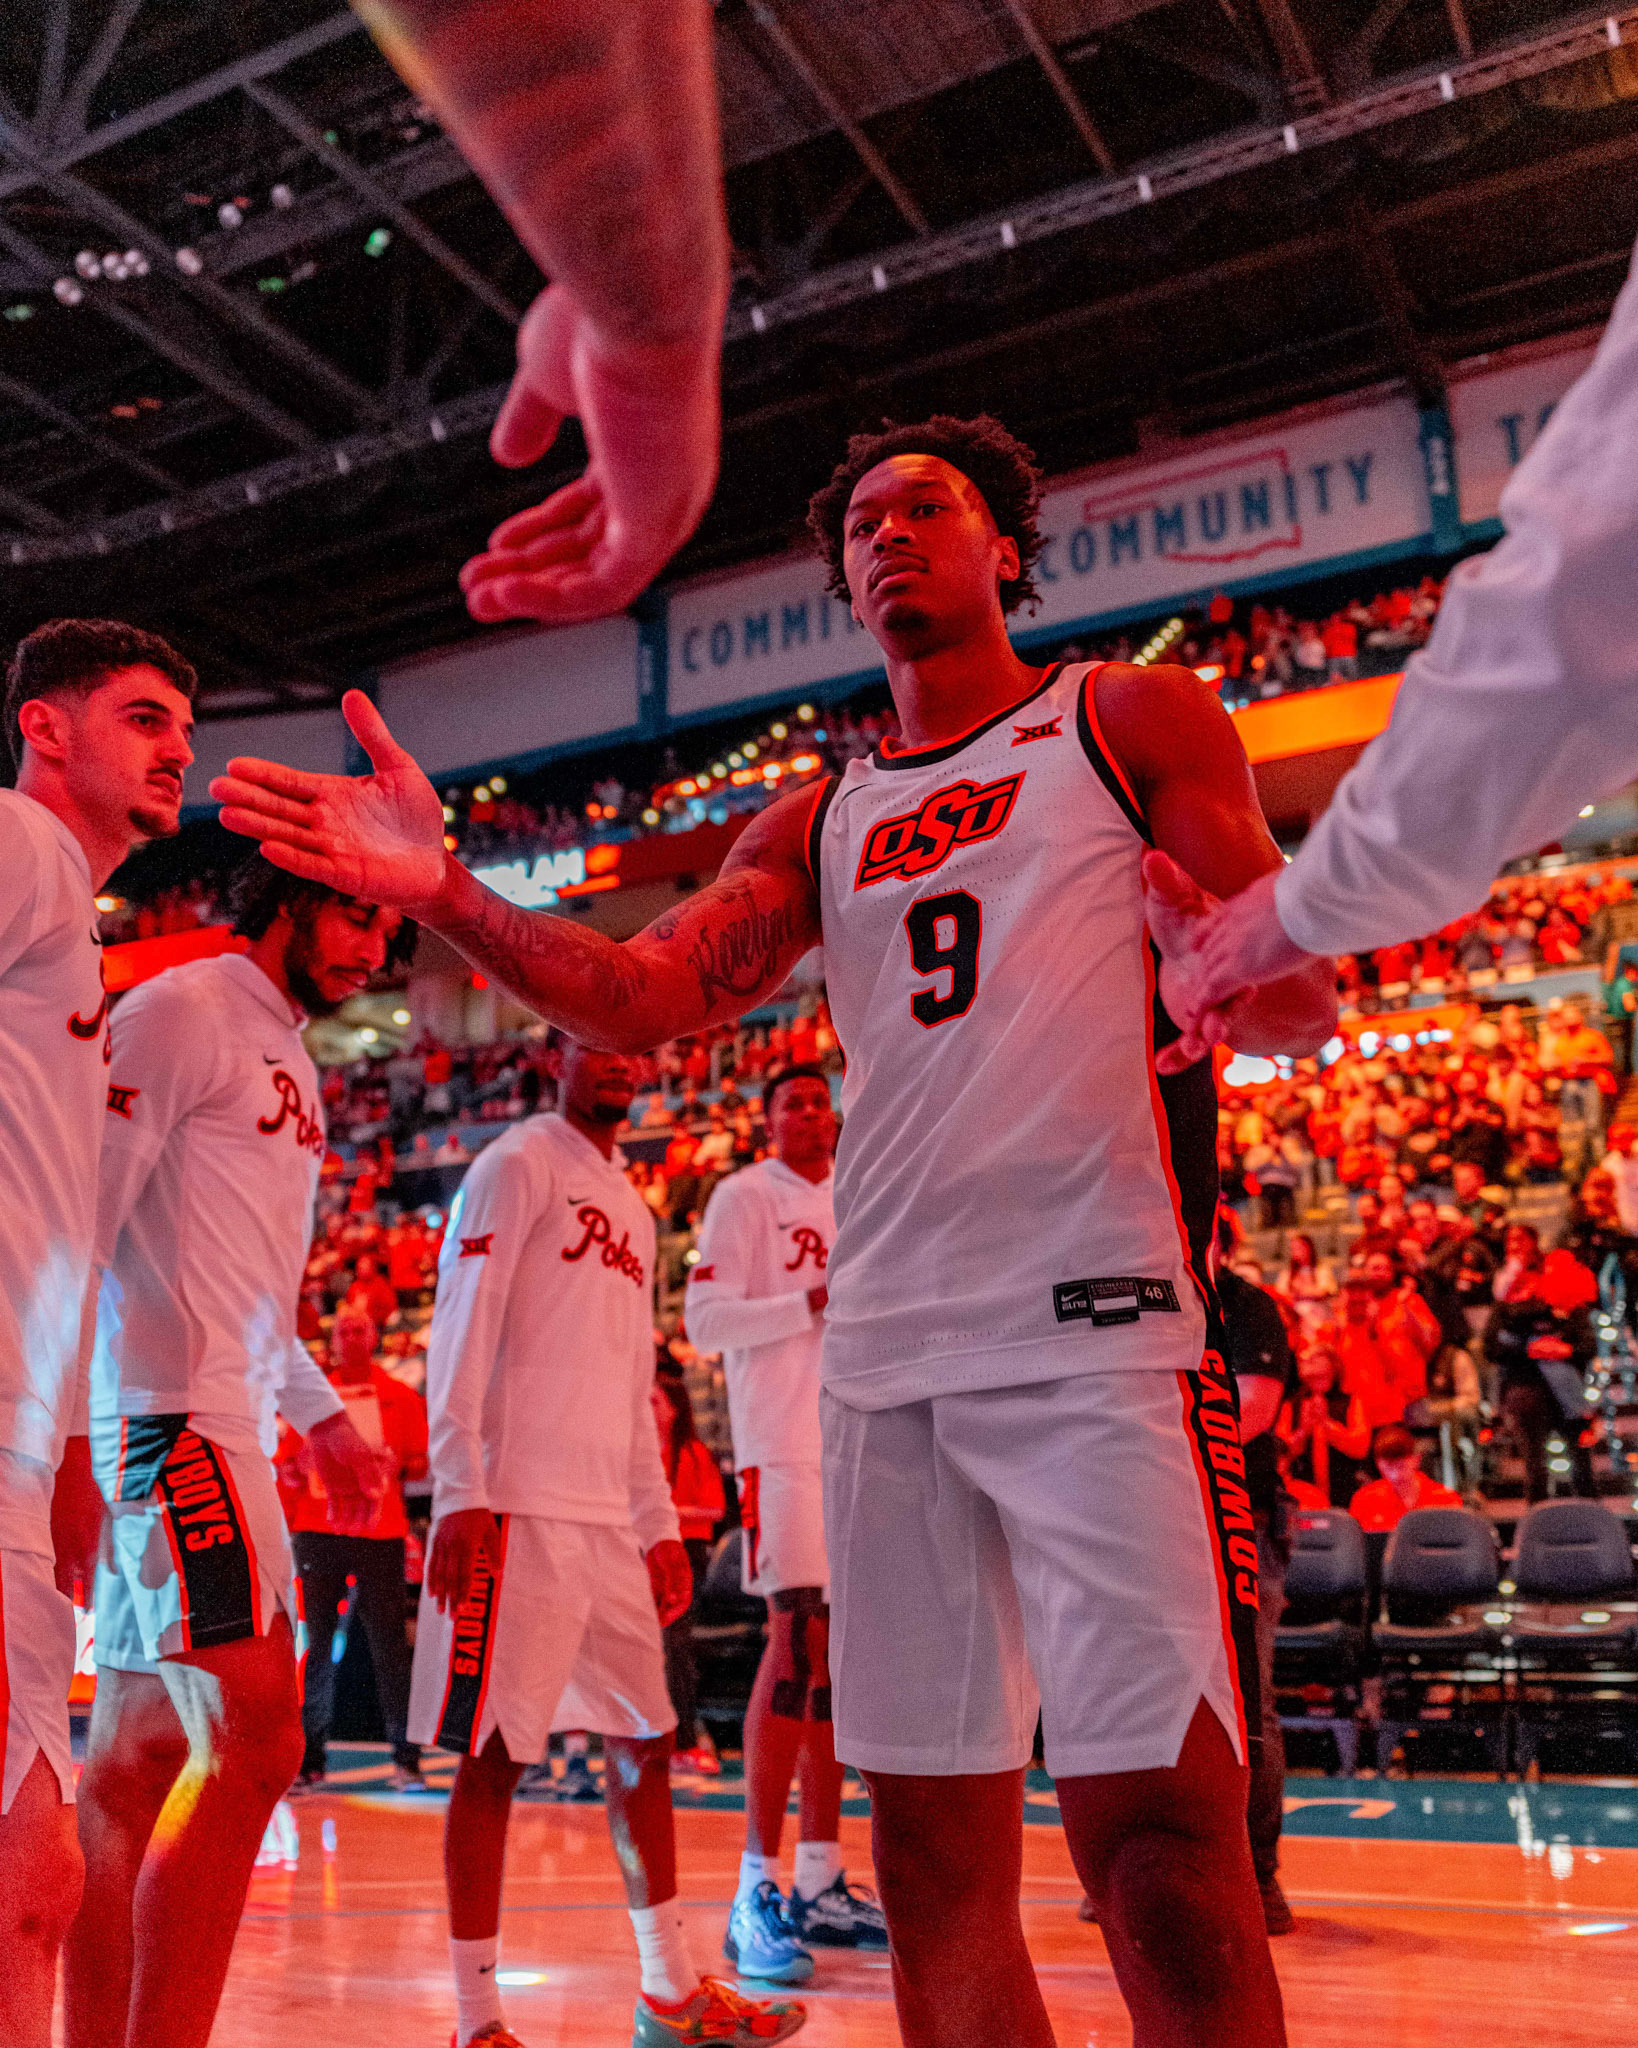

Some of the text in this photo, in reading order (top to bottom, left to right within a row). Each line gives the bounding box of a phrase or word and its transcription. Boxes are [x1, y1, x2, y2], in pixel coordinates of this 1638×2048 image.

[1039, 451, 1373, 582] COMMUNITY
[854, 769, 1027, 892] OSU
[903, 888, 982, 1030] 9
[561, 1206, 644, 1288] Pokes
[1145, 1286, 1163, 1300] 46
[1198, 1348, 1260, 1612] COWBOYS
